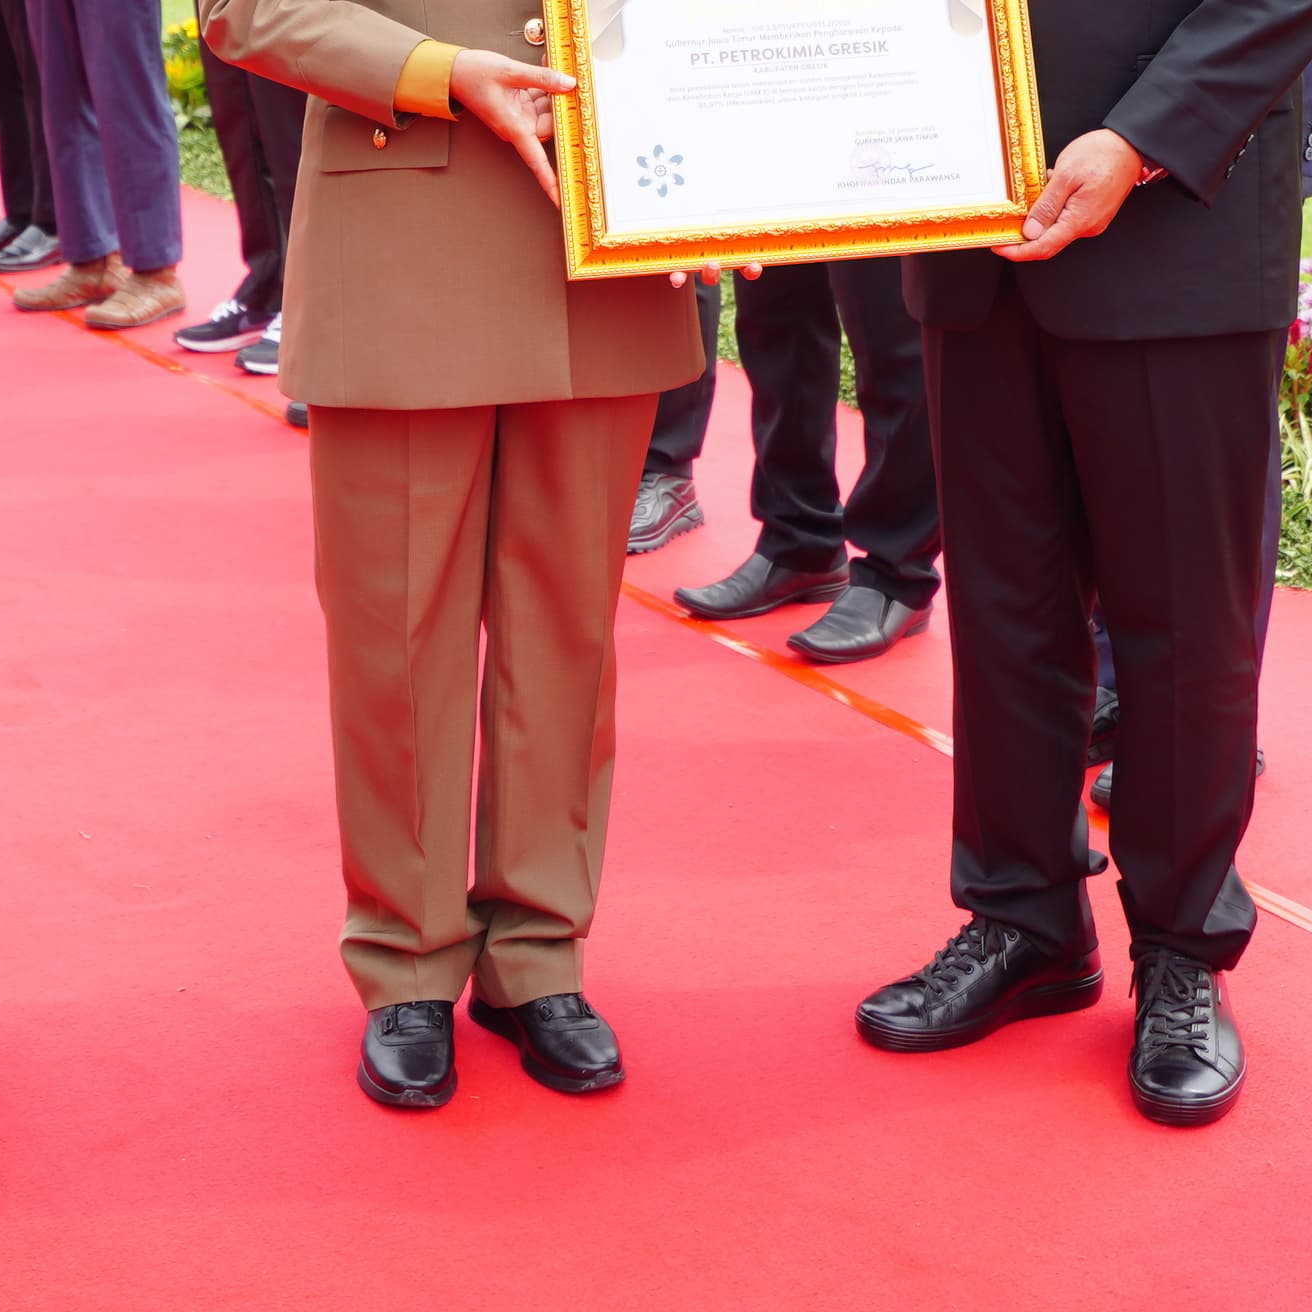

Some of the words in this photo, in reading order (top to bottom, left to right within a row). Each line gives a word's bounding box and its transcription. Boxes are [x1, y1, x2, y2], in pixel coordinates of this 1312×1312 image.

[690, 52, 714, 65] PT.
[719, 44, 824, 63] PETROKIMIA
[827, 39, 888, 56] GRESIK
[909, 172, 960, 183] PARAWANSA
